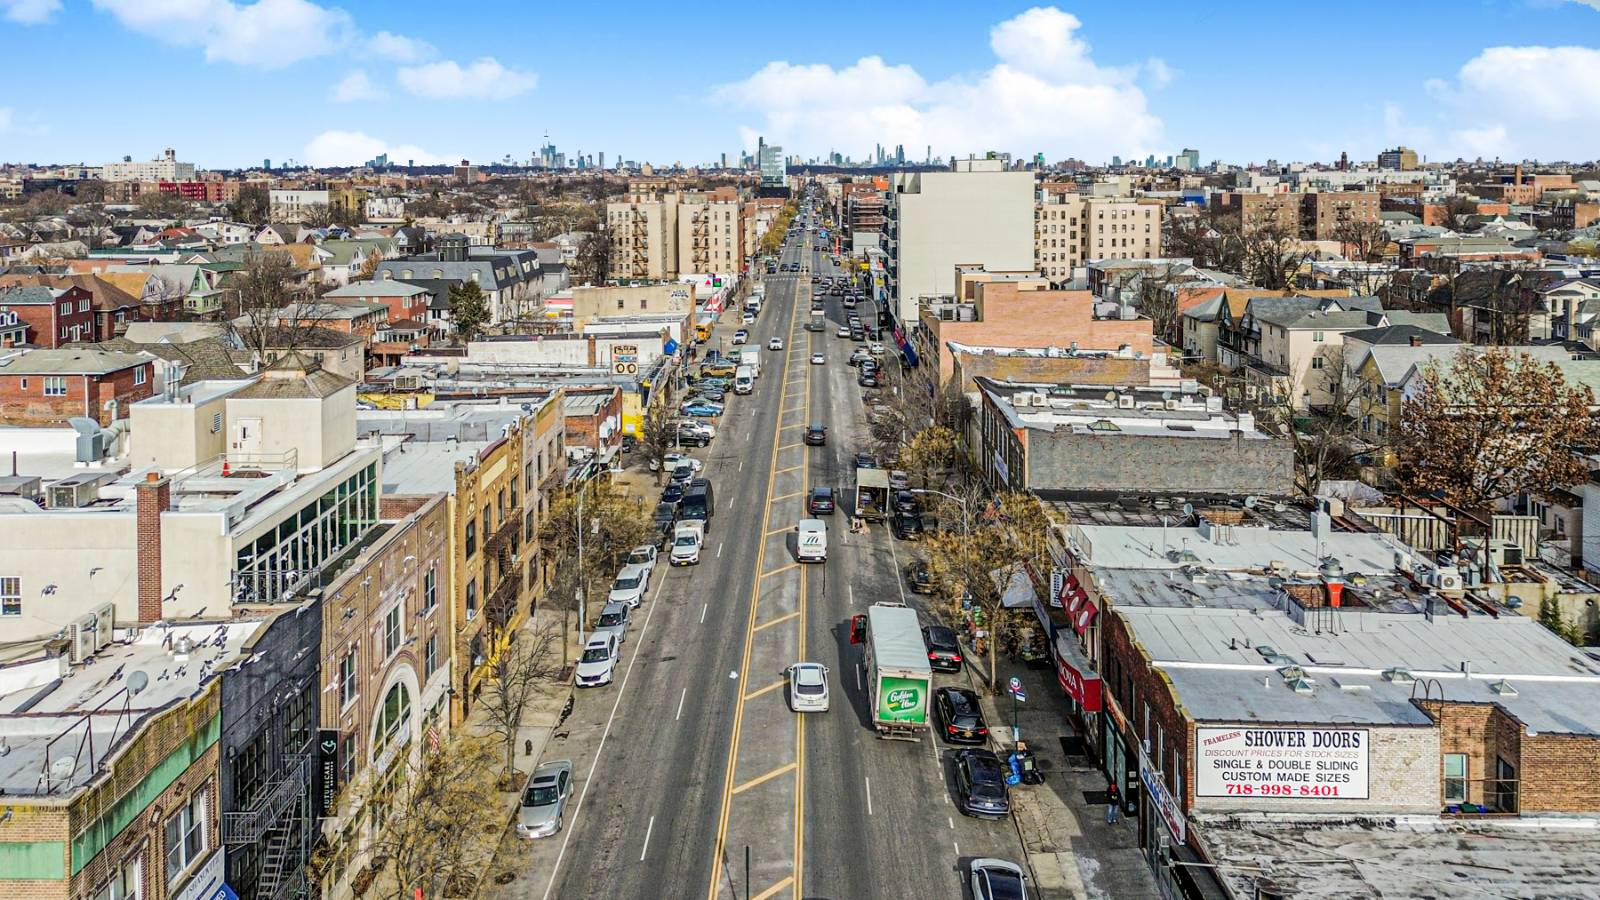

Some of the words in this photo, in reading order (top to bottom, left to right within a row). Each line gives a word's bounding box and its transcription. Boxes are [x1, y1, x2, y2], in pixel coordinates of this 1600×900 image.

[1202, 731, 1241, 746] FRAMELESS
[1245, 731, 1306, 747] SHOWER
[1313, 732, 1360, 748] DOORS
[1305, 750, 1332, 758] STOCK
[1214, 760, 1251, 769] SINGLE
[1256, 760, 1263, 769] &
[1269, 761, 1311, 770] DOUBLE
[1316, 761, 1358, 770] SLIDING
[1222, 772, 1271, 781] CUSTOM
[1277, 773, 1310, 782] MADE
[1316, 773, 1350, 782] SIZES
[1226, 784, 1338, 795] 718-998-8401
